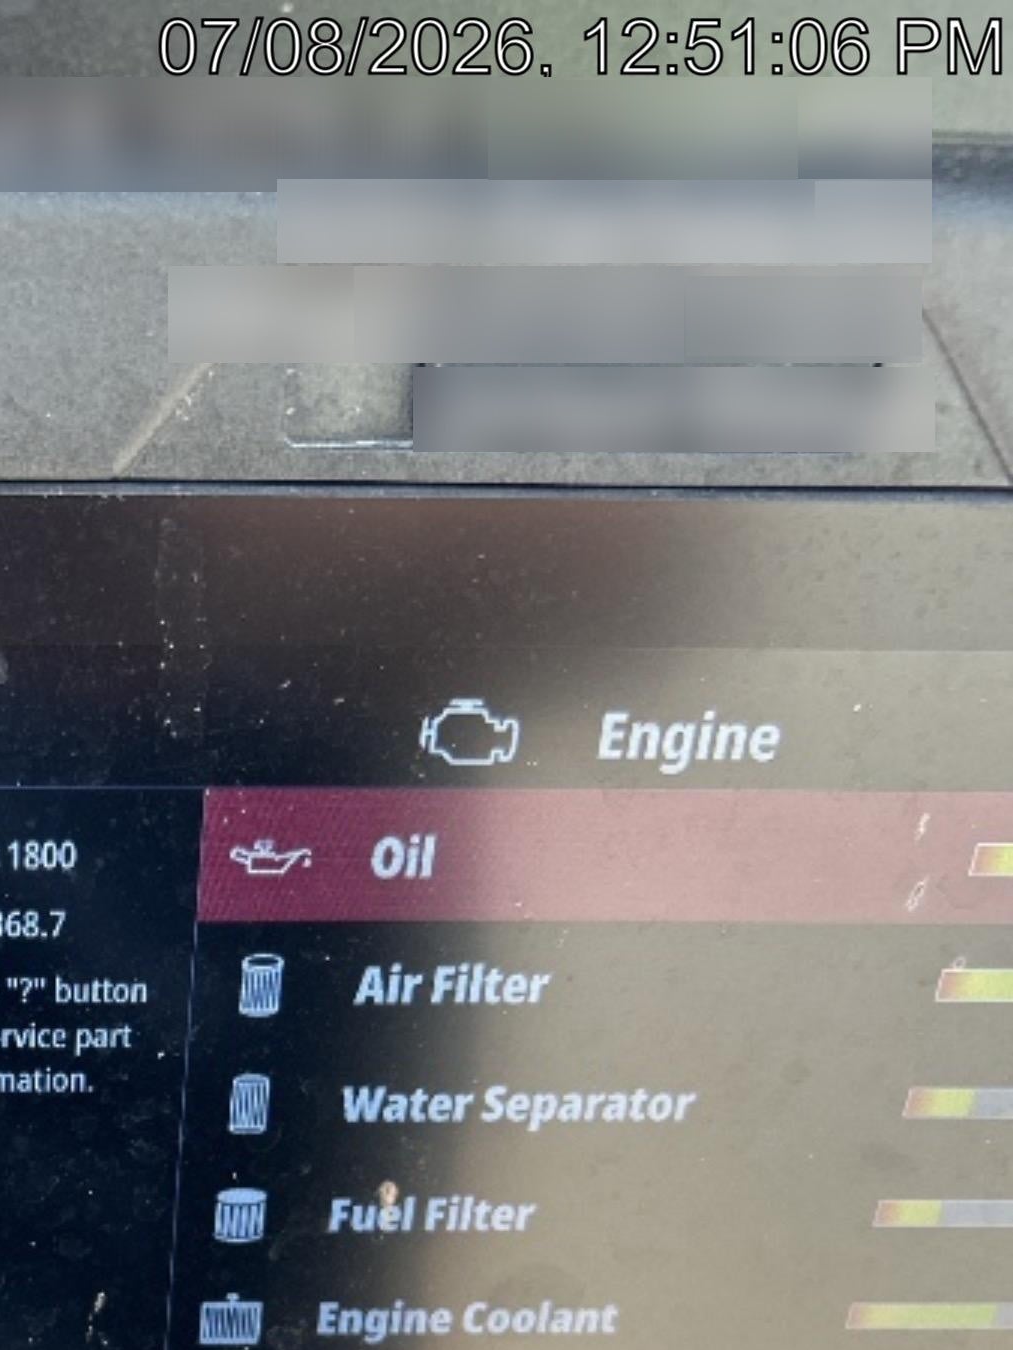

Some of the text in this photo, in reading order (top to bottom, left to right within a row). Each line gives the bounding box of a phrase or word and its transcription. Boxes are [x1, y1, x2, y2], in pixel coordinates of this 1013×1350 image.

[597, 711, 781, 774] Engine
[8, 840, 77, 870] 1800
[371, 834, 436, 879] Oil
[6, 978, 46, 1003] "?"
[55, 977, 148, 1003] button
[353, 963, 550, 1005] Air Filter
[76, 1026, 132, 1056] part
[342, 1084, 697, 1131] Water Separator
[328, 1194, 536, 1232] Fuel Filter
[317, 1300, 618, 1344] Engine Coolant
